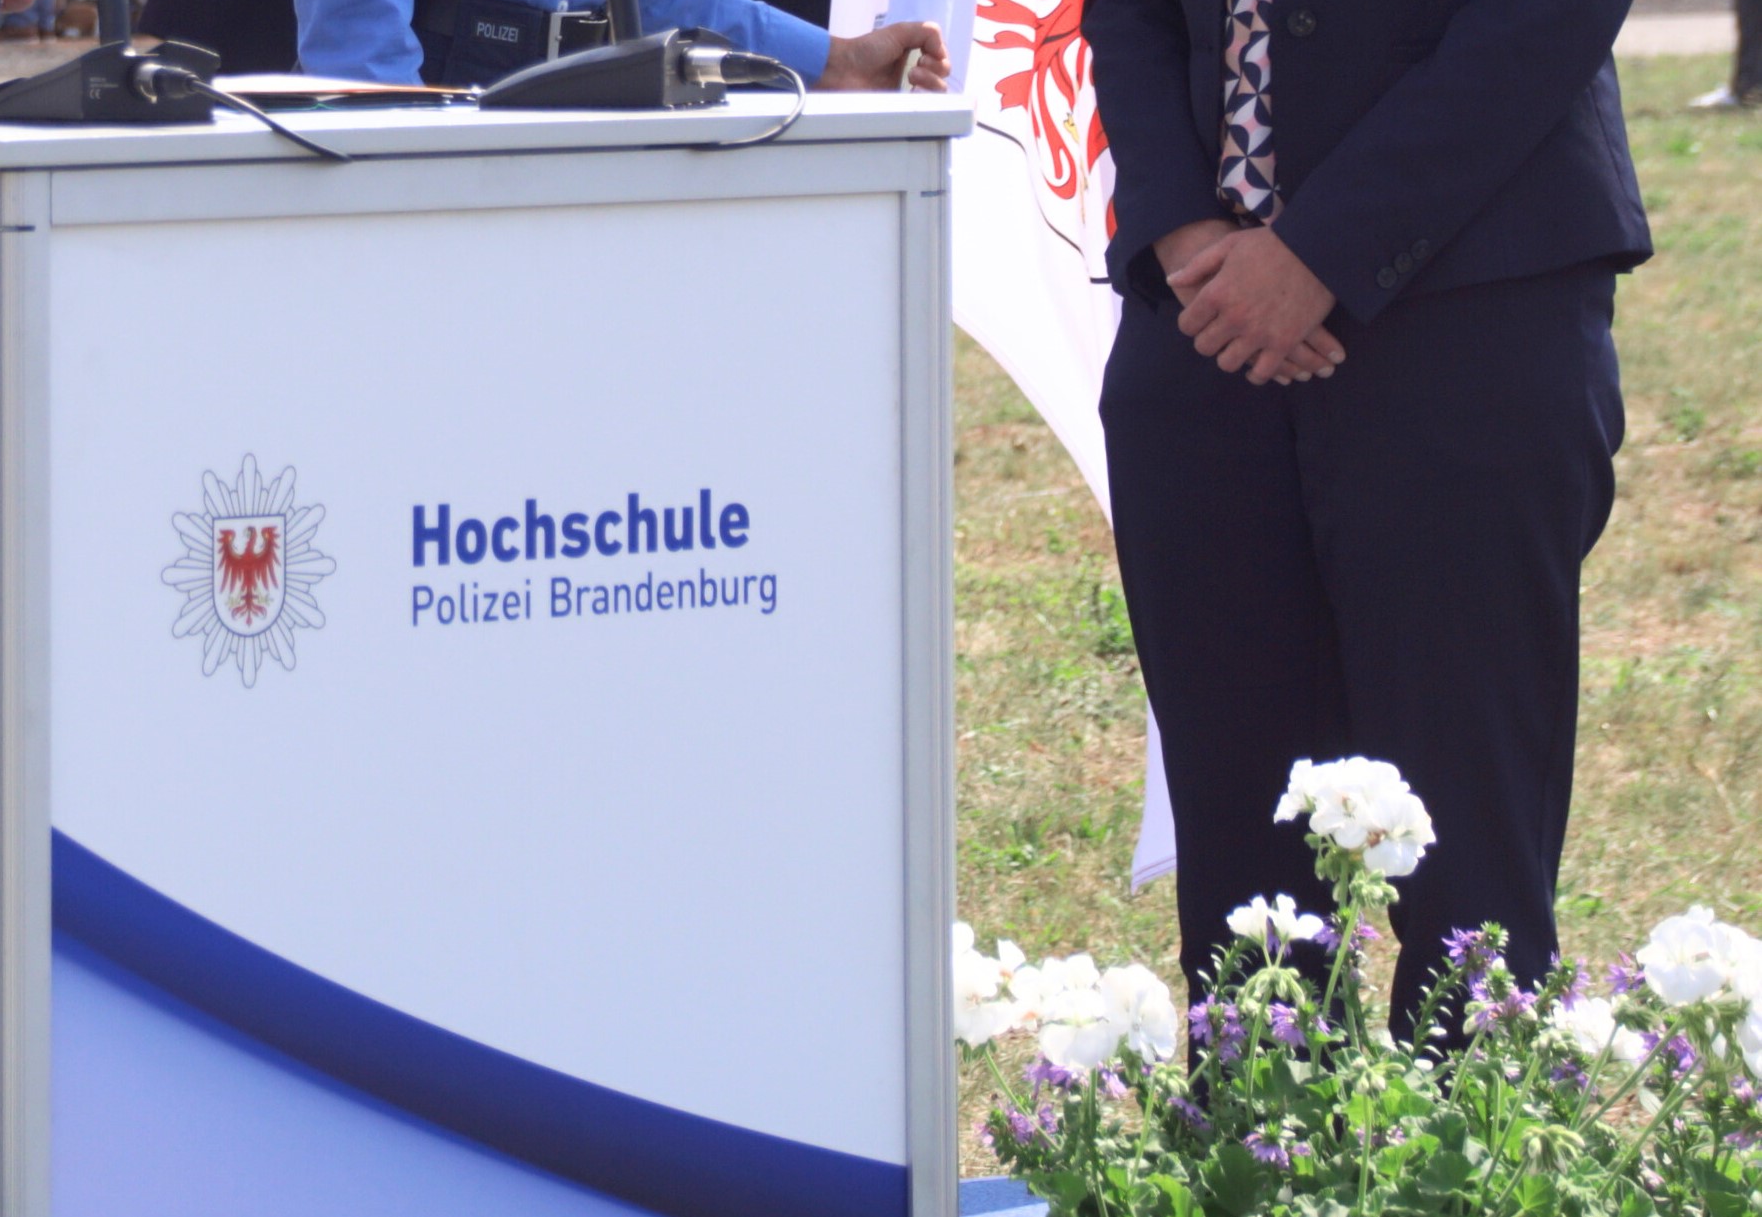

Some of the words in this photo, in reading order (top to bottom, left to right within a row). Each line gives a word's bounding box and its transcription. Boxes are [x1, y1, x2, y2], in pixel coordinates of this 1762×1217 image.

[477, 22, 519, 43] POLIZEI
[412, 488, 750, 567] Hochschule
[412, 578, 531, 627] Polizei
[550, 567, 777, 618] Brandenburg
